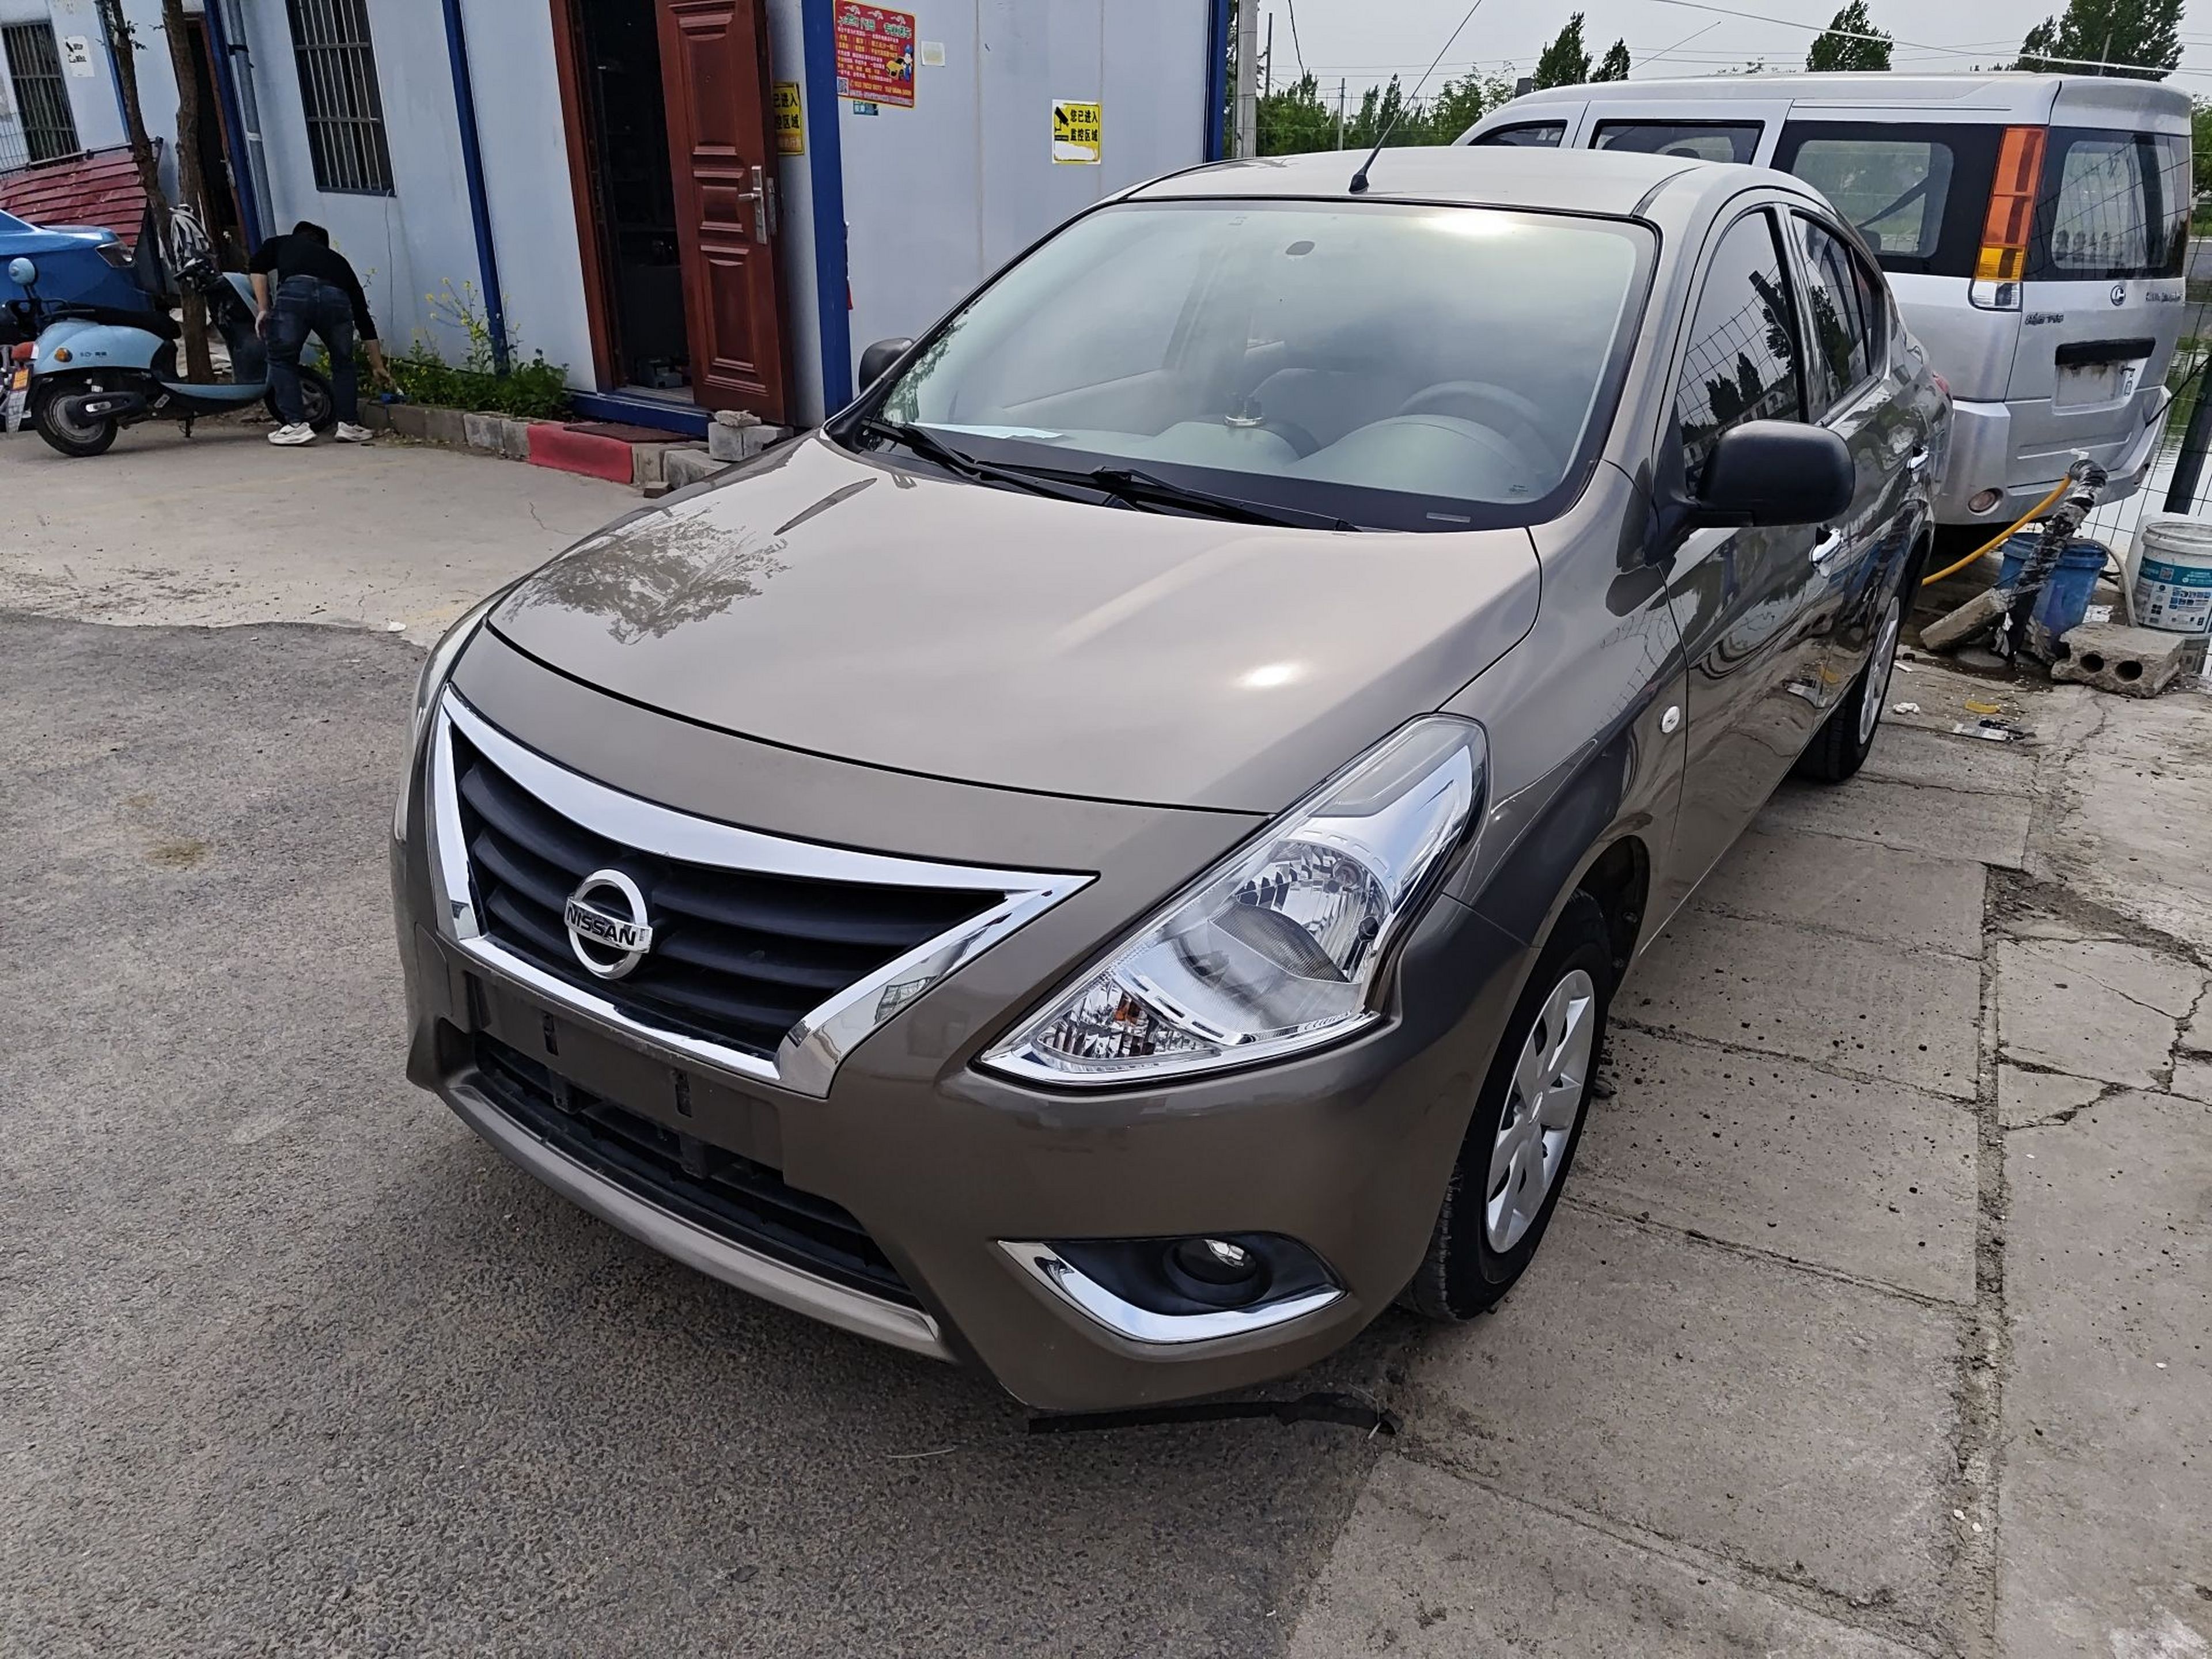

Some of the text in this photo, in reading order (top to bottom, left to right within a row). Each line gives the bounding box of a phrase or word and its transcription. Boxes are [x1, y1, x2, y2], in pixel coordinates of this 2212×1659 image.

[1070, 109, 1097, 123] 您已进入
[1070, 128, 1097, 142] 监控区域
[567, 904, 636, 946] NISSAN
